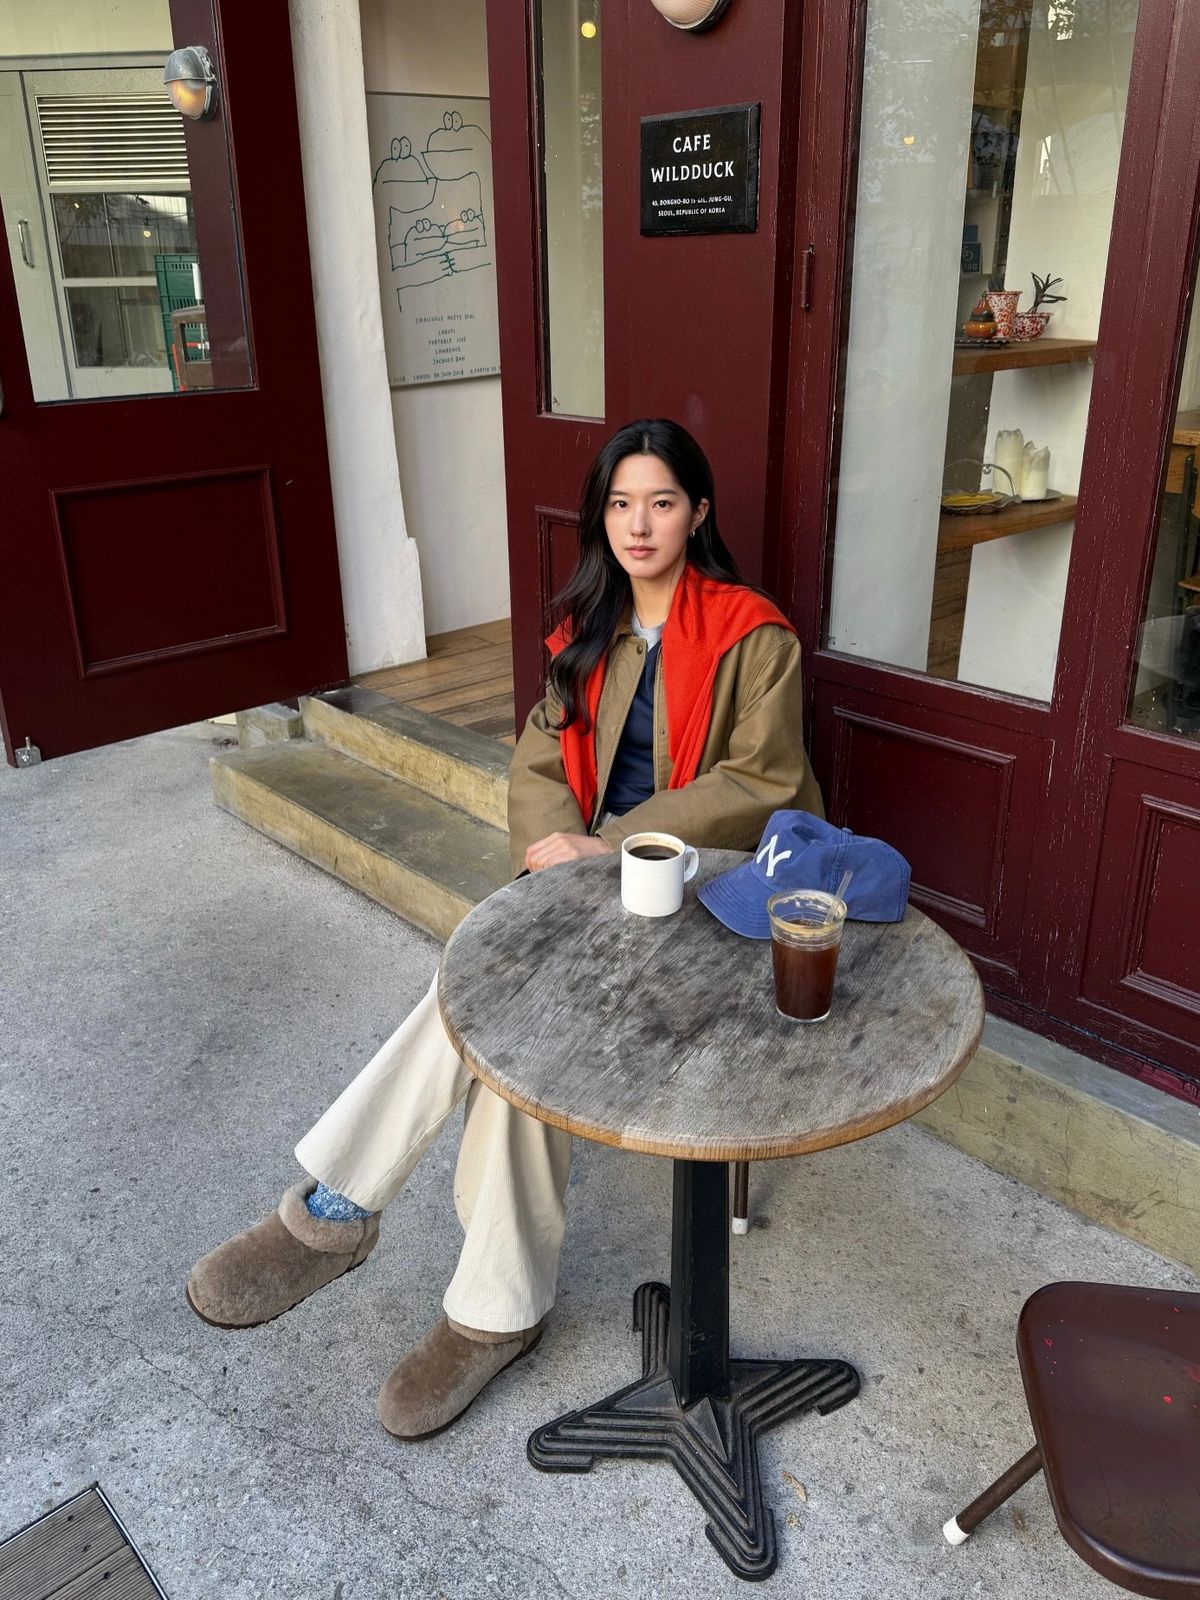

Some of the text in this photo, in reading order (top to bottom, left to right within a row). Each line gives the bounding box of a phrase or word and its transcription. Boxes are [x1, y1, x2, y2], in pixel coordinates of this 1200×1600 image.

[672, 134, 711, 153] CAFE
[650, 161, 734, 183] WILDDUCK
[676, 208, 699, 216] REPUBLIC
